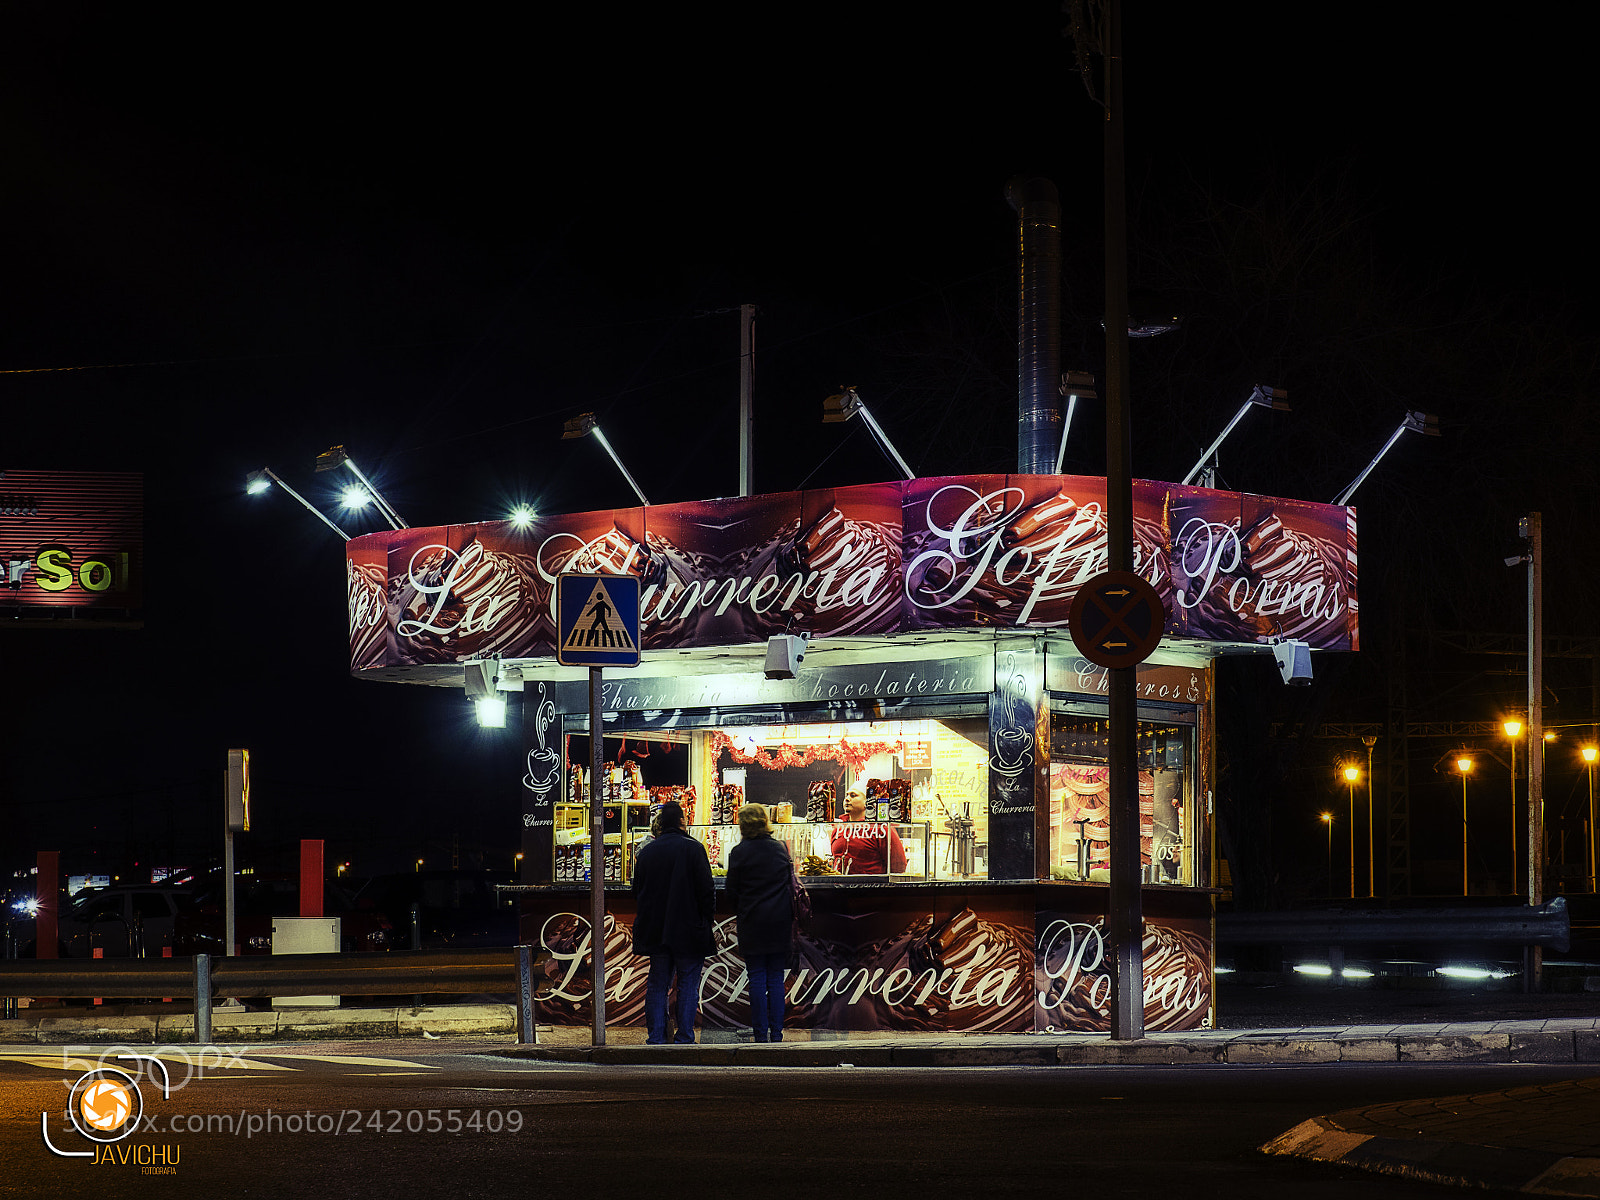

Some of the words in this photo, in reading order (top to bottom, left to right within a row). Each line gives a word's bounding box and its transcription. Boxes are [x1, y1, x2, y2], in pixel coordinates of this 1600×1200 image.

[1176, 517, 1344, 621] Porras
[397, 544, 507, 640] La
[788, 669, 976, 699] Chocolateria
[1073, 659, 1180, 699] Chros
[535, 793, 549, 807] La
[1005, 777, 1021, 792] La
[836, 822, 888, 839] PORRAS
[534, 912, 637, 1003] La
[1038, 919, 1206, 1011] Poras
